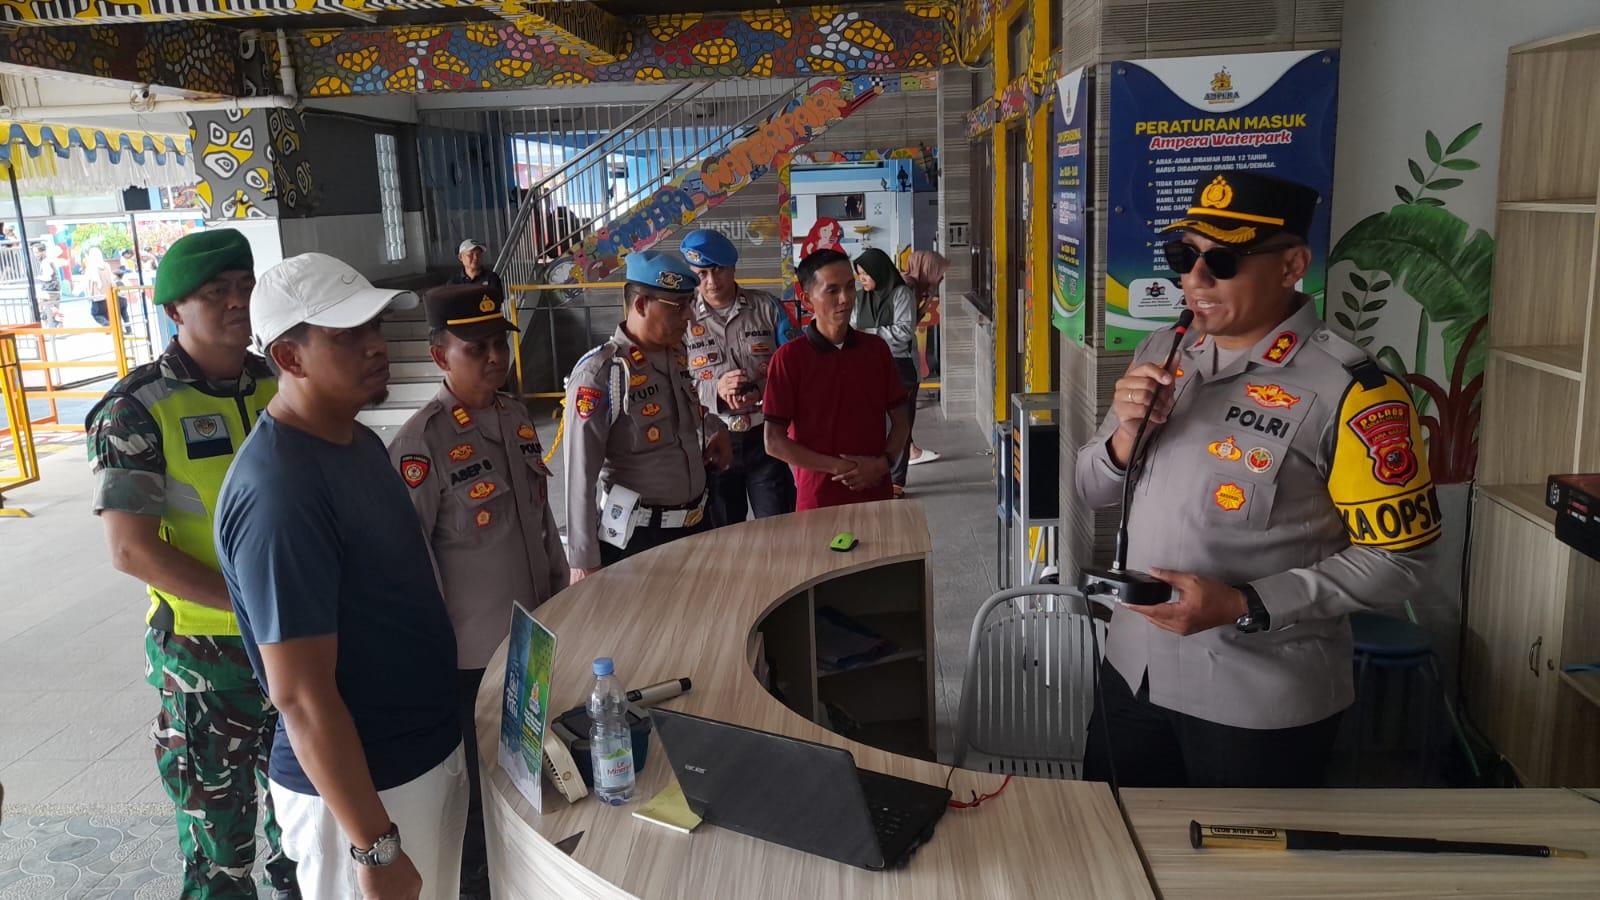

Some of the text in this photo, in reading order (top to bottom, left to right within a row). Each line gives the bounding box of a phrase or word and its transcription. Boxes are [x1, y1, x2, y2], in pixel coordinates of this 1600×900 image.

[1135, 114, 1306, 135] PERATURAN MASUK
[1150, 130, 1291, 151] Ampera Waterpark
[629, 384, 660, 401] YUDI
[1225, 406, 1290, 438] POLRI
